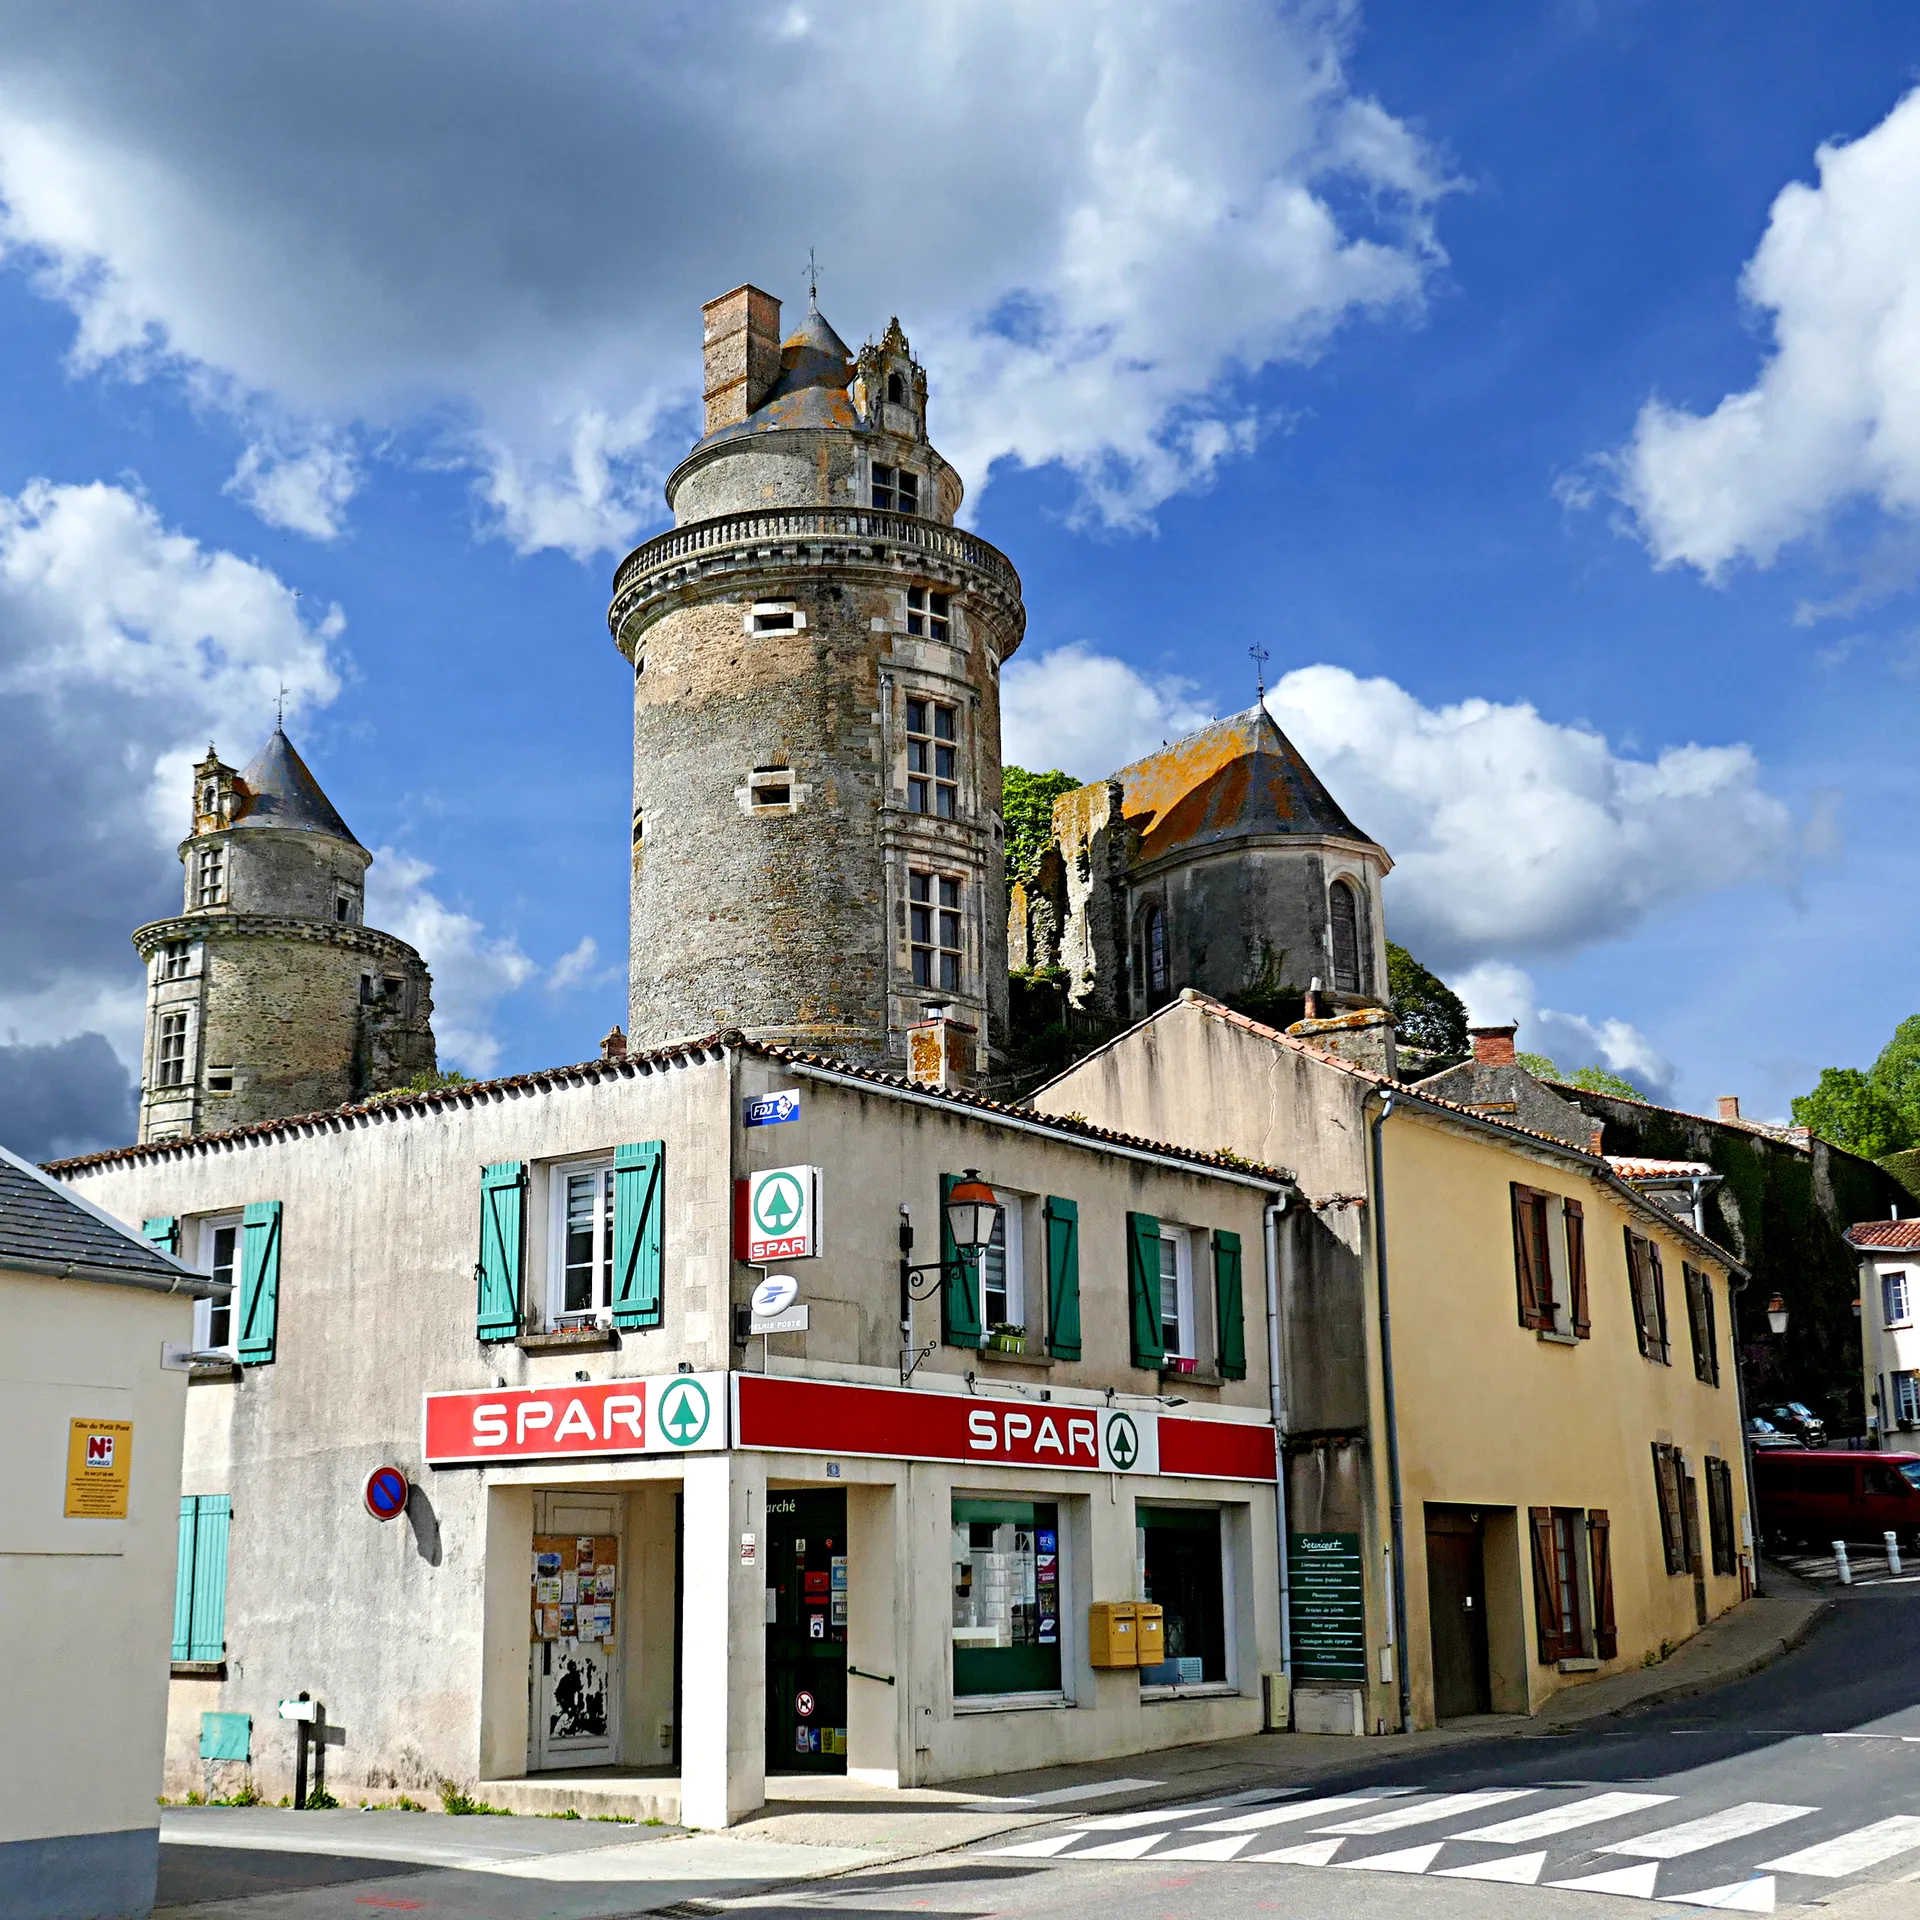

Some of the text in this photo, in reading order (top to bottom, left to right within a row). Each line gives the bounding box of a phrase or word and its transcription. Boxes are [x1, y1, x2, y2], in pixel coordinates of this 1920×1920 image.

[754, 1103, 774, 1117] FDJ
[753, 1239, 804, 1257] SPAR
[748, 1319, 801, 1331] RELAIS POSTE
[472, 1395, 643, 1447] SPAR
[968, 1409, 1096, 1457] SPAR
